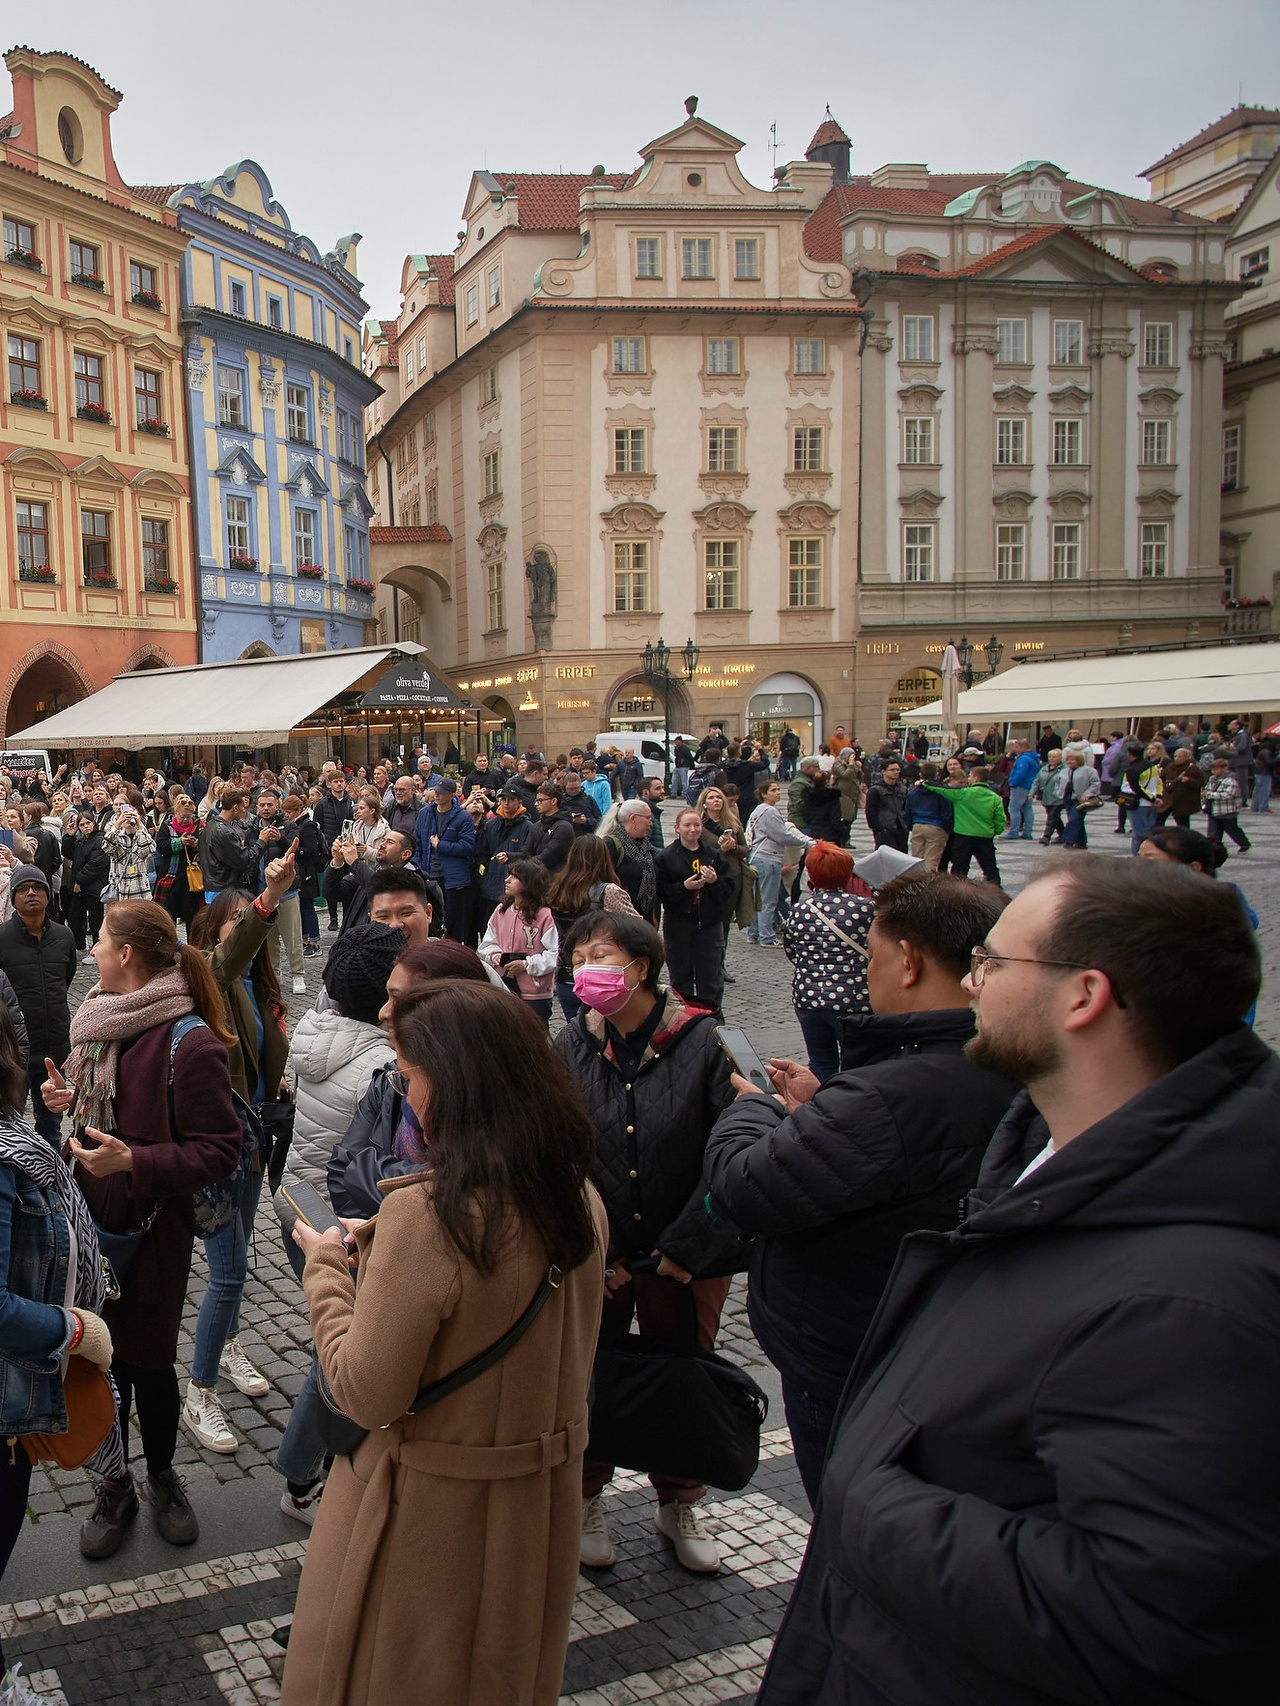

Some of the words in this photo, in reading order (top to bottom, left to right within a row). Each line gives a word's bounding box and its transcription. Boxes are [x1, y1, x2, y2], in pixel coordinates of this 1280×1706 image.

[555, 666, 596, 679] ERPET
[396, 676, 411, 687] oliva
[898, 678, 938, 692] ERPET
[618, 700, 656, 712] ERPET
[888, 696, 913, 704] STEAK
[523, 926, 539, 949] Y
